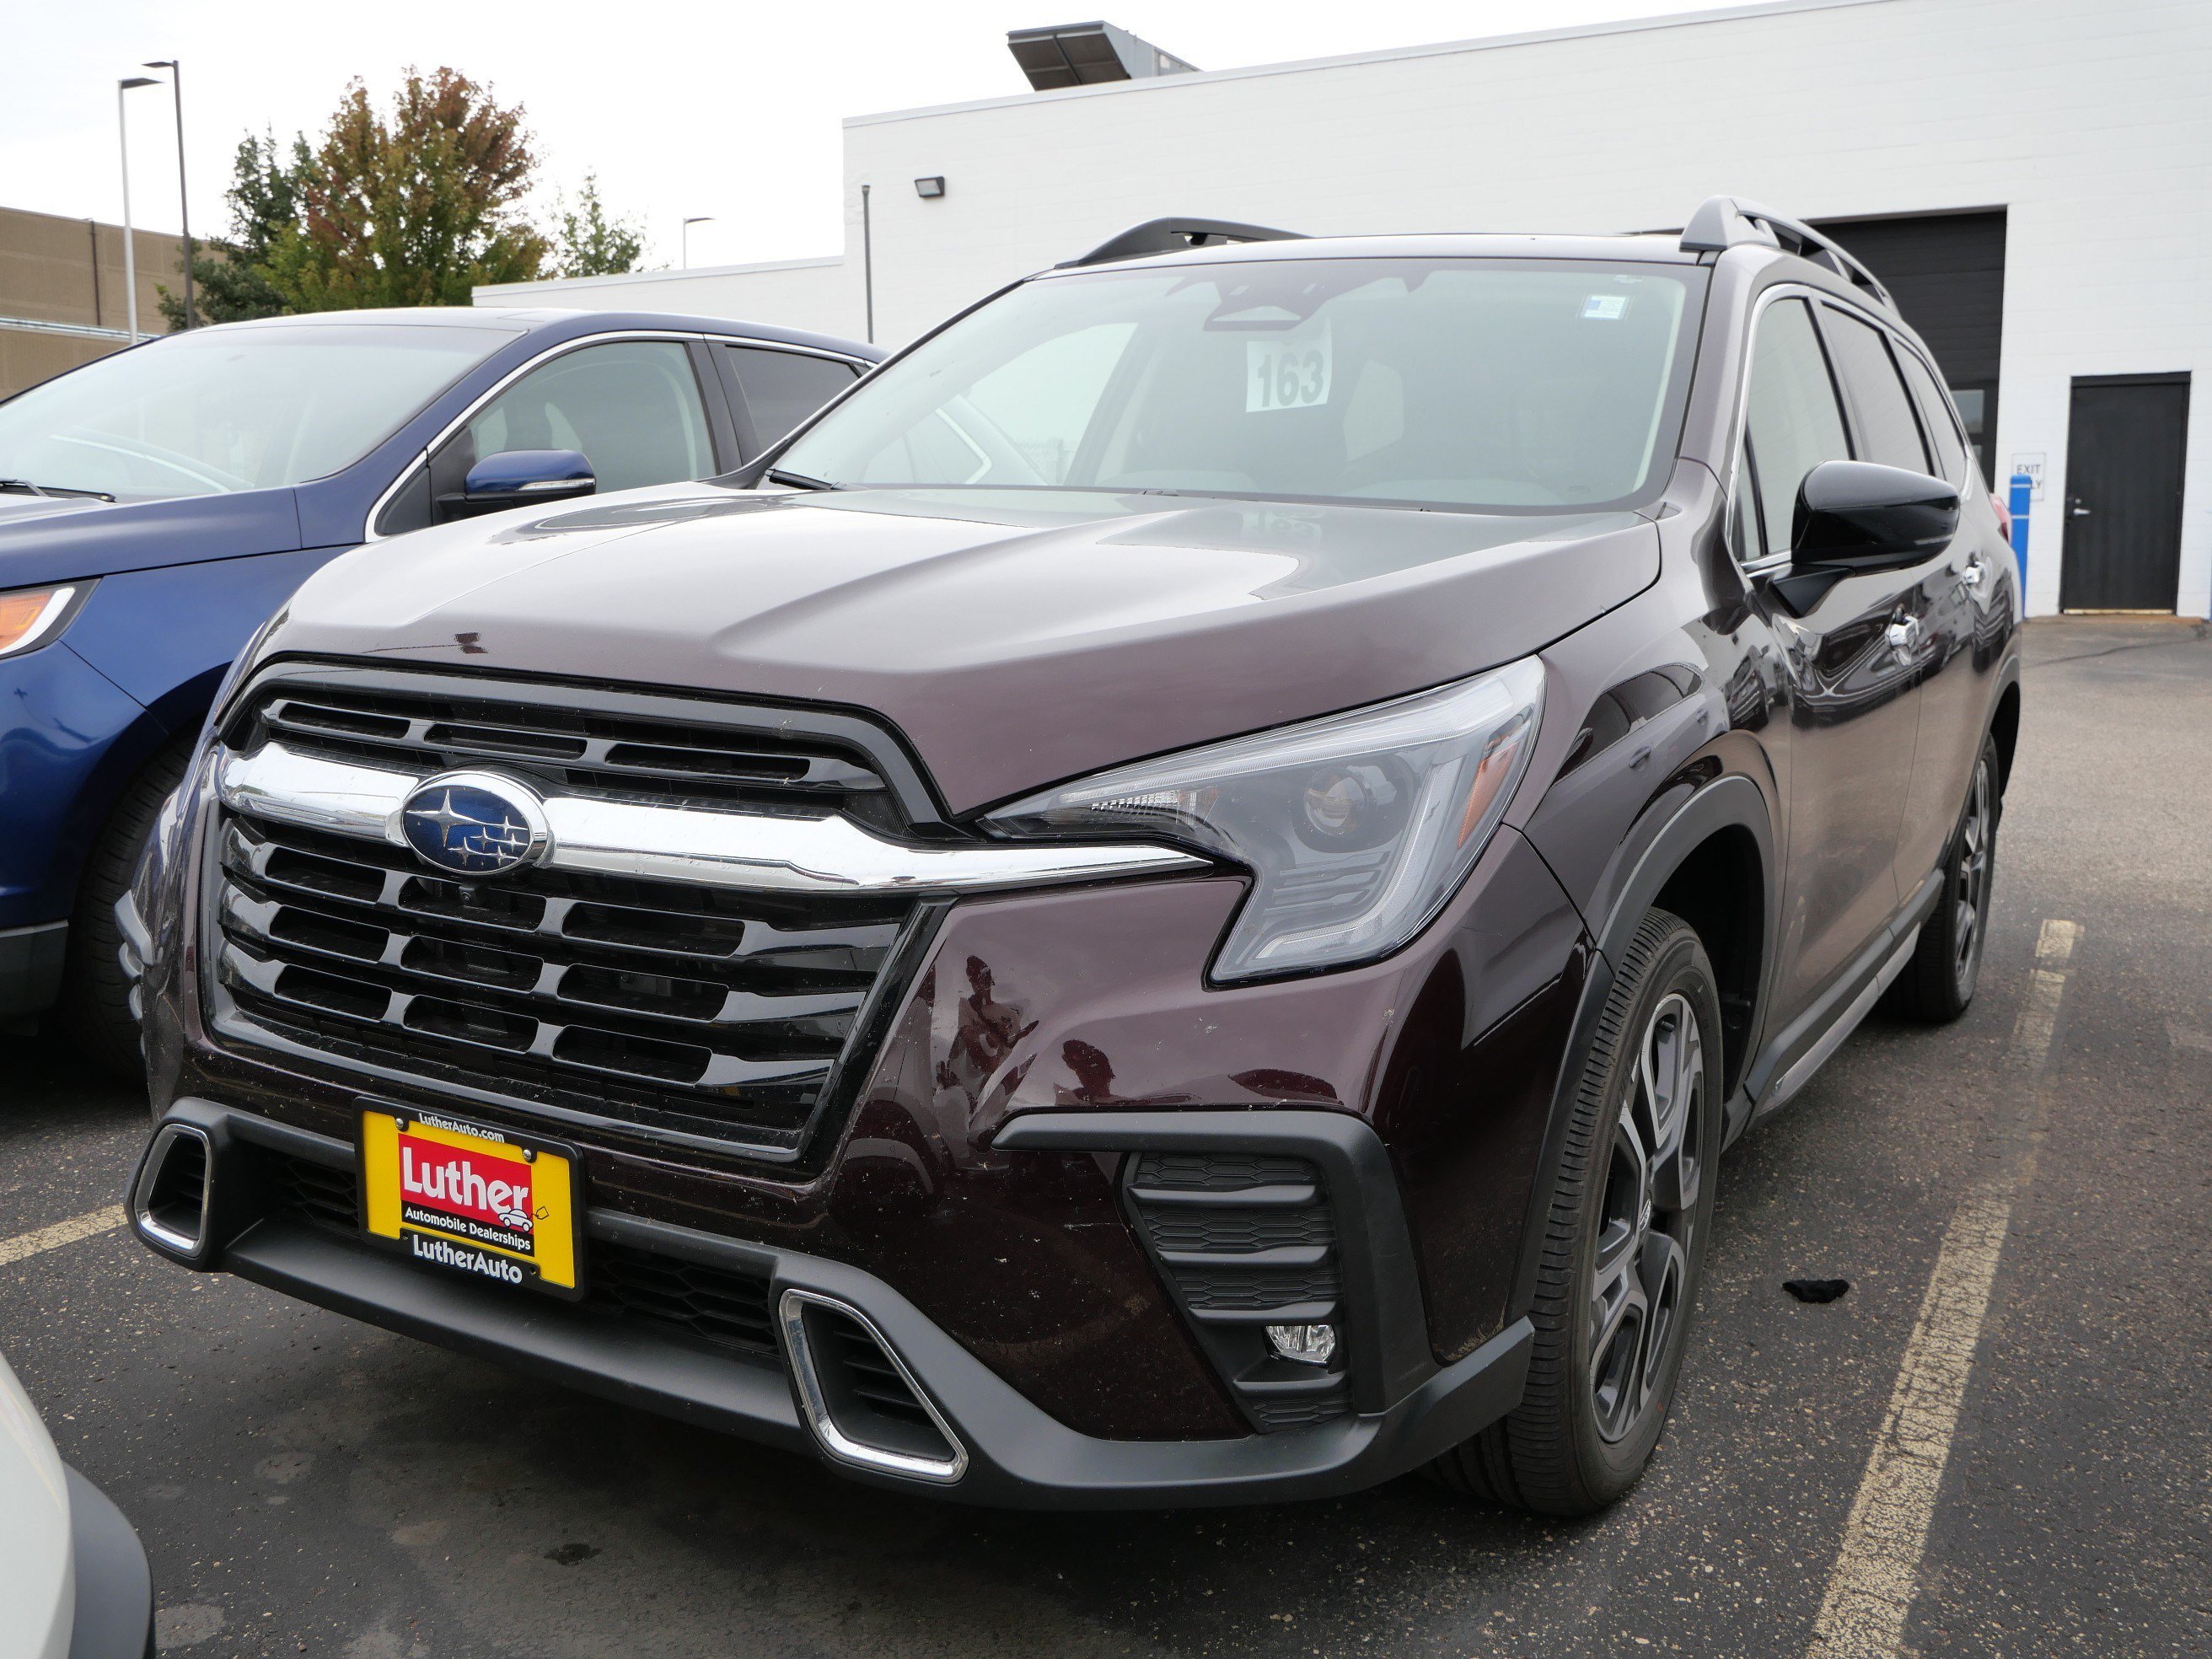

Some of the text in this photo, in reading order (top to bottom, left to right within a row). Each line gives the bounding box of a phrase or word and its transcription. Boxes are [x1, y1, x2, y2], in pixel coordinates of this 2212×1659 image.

[1257, 349, 1323, 408] 163
[2016, 464, 2041, 474] EXIT
[418, 1113, 505, 1143] LutherAuto.com
[402, 1146, 529, 1215] Luther
[405, 1206, 531, 1251] Automobile Dealerships
[412, 1234, 523, 1285] LutherAuto
